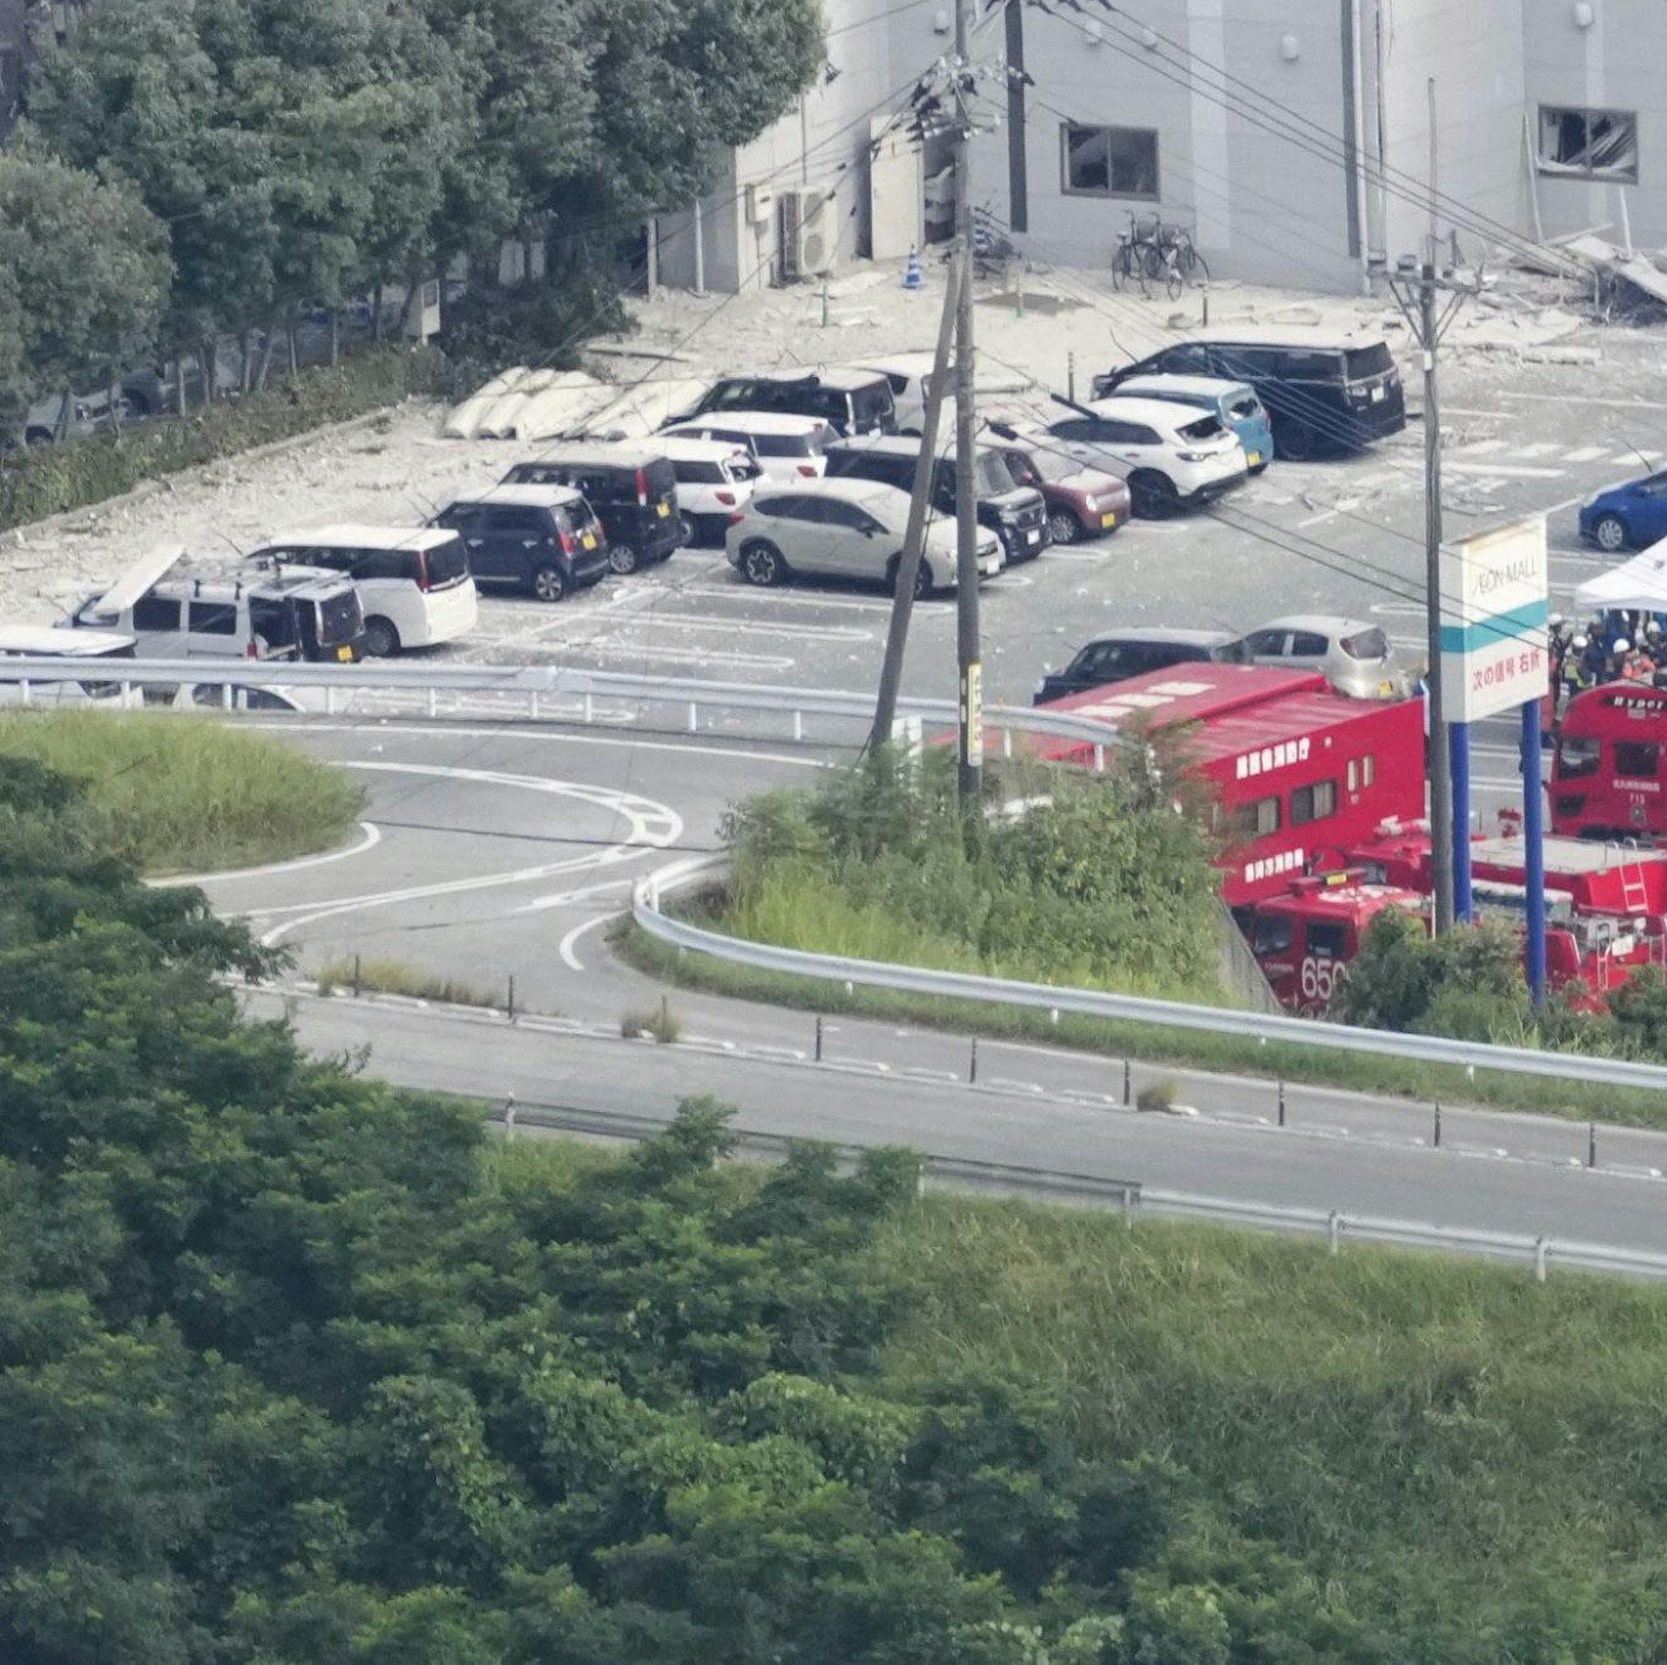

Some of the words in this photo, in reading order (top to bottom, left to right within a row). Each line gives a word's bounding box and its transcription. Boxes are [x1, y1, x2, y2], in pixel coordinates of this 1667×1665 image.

[1506, 556, 1538, 584] MALL
[1472, 656, 1515, 692] 次の信号
[1519, 648, 1541, 674] 右折
[1612, 695, 1664, 710] Hyper
